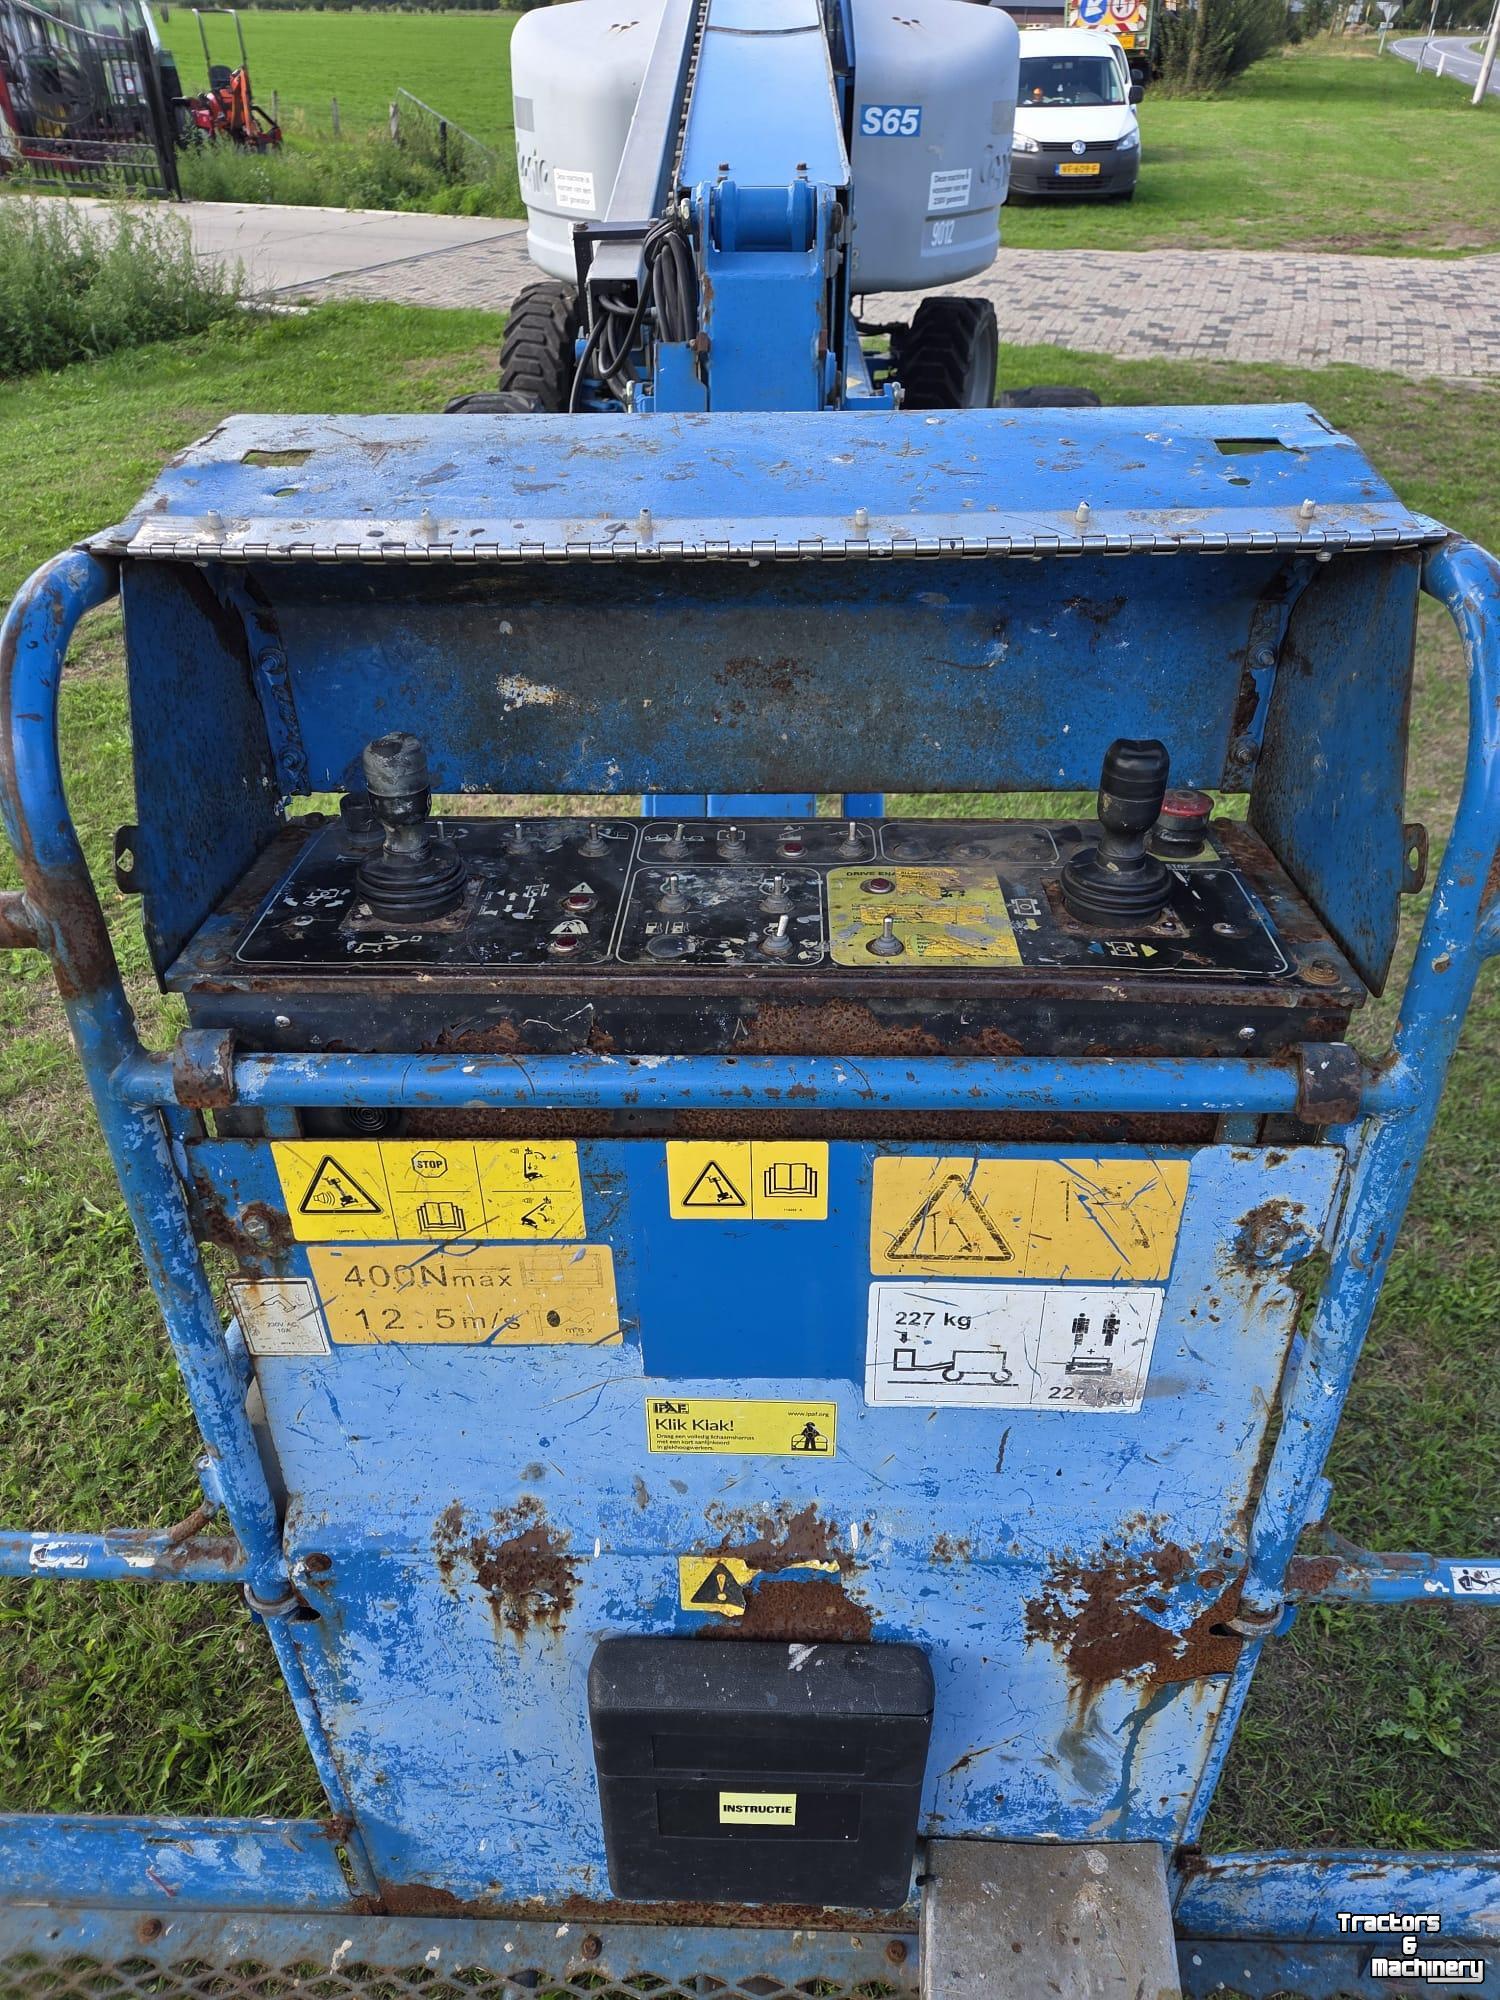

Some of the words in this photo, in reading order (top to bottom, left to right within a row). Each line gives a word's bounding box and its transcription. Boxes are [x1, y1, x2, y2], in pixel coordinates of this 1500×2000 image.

[862, 107, 920, 135] S65
[931, 220, 956, 246] 9012
[417, 1160, 443, 1169] STOP
[895, 1312, 934, 1326] 227
[944, 1312, 972, 1330] kg
[1048, 1386, 1085, 1400] 227
[655, 1418, 688, 1430] Klik
[723, 1804, 793, 1814] INSTRUCTIE
